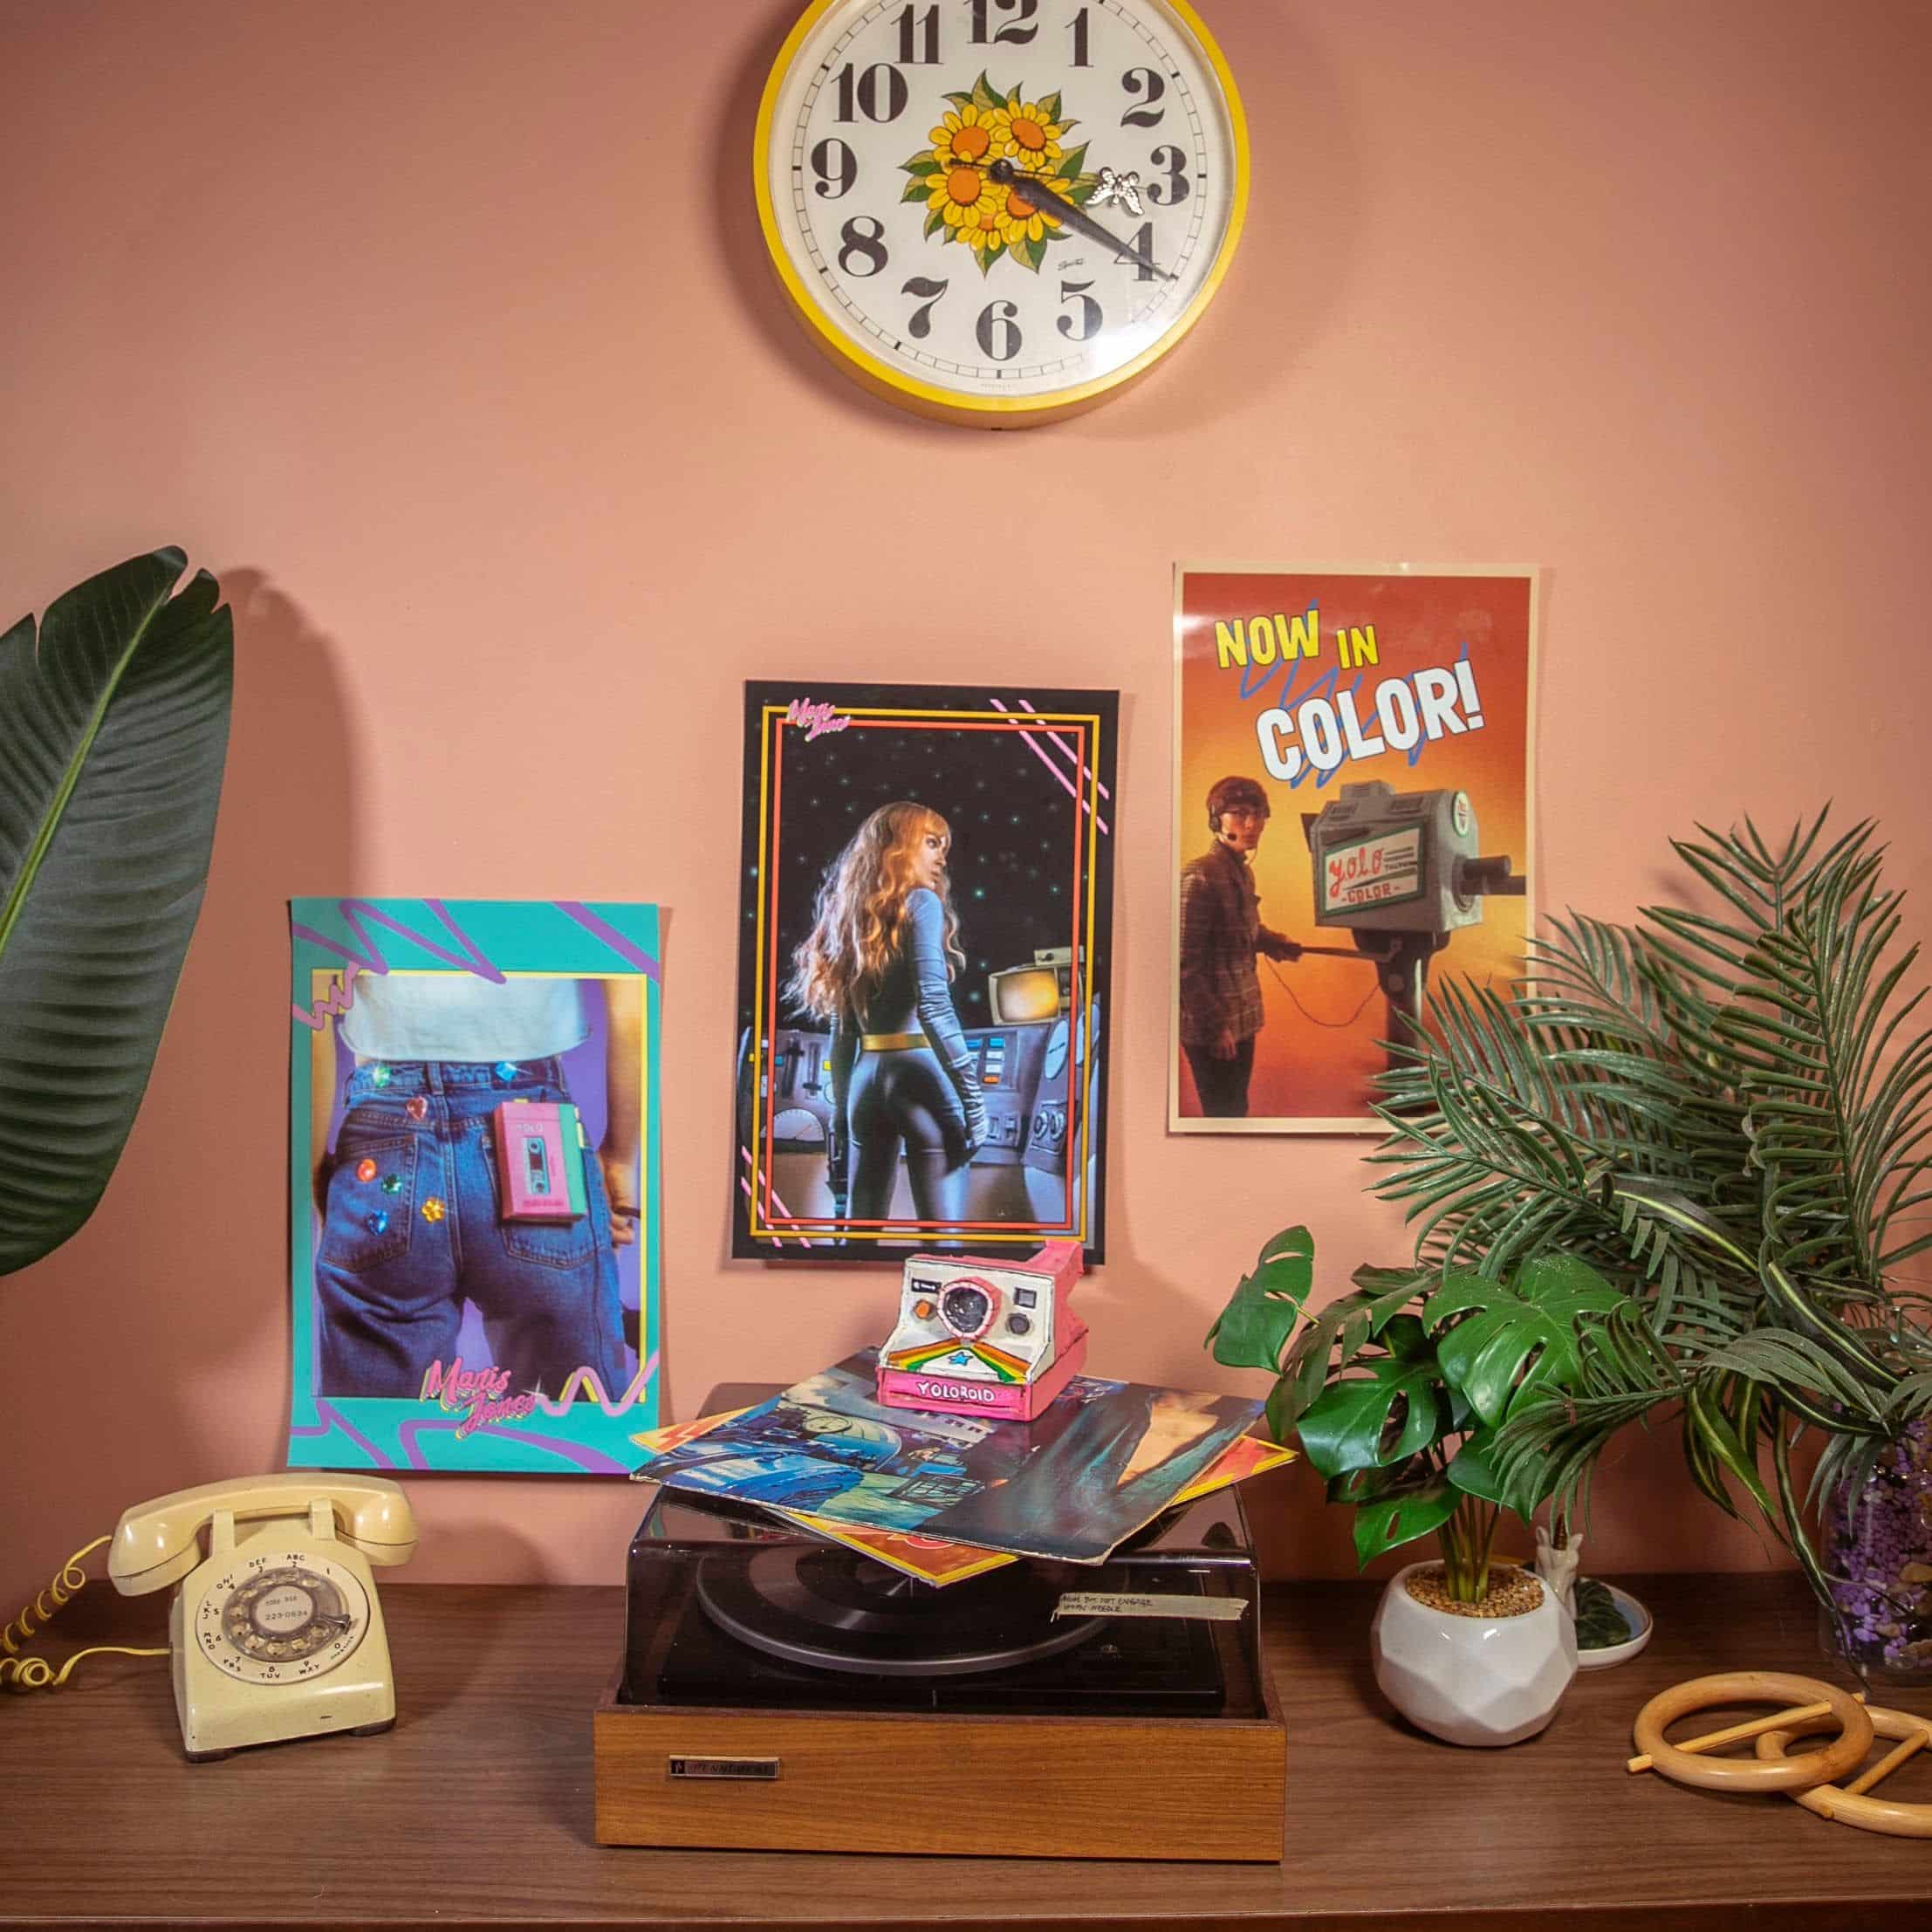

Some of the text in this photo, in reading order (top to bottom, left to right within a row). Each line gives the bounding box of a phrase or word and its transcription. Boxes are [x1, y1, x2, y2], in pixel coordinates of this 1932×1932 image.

[890, 3, 945, 65] 11
[963, 0, 1039, 45] 12
[1063, 7, 1095, 67] 1
[831, 62, 908, 123] 10
[1120, 67, 1166, 127] 2
[811, 138, 858, 199] 9
[1146, 145, 1190, 206] 3
[838, 216, 888, 277] 8
[1113, 222, 1161, 281] 4
[901, 277, 949, 339] 7
[976, 299, 1023, 361] 6
[1057, 279, 1103, 341] 5
[1214, 608, 1380, 670] NOW IN
[1255, 659, 1485, 782] COLOR!
[421, 1355, 512, 1411] Maris
[916, 1381, 995, 1402] YOLOROID
